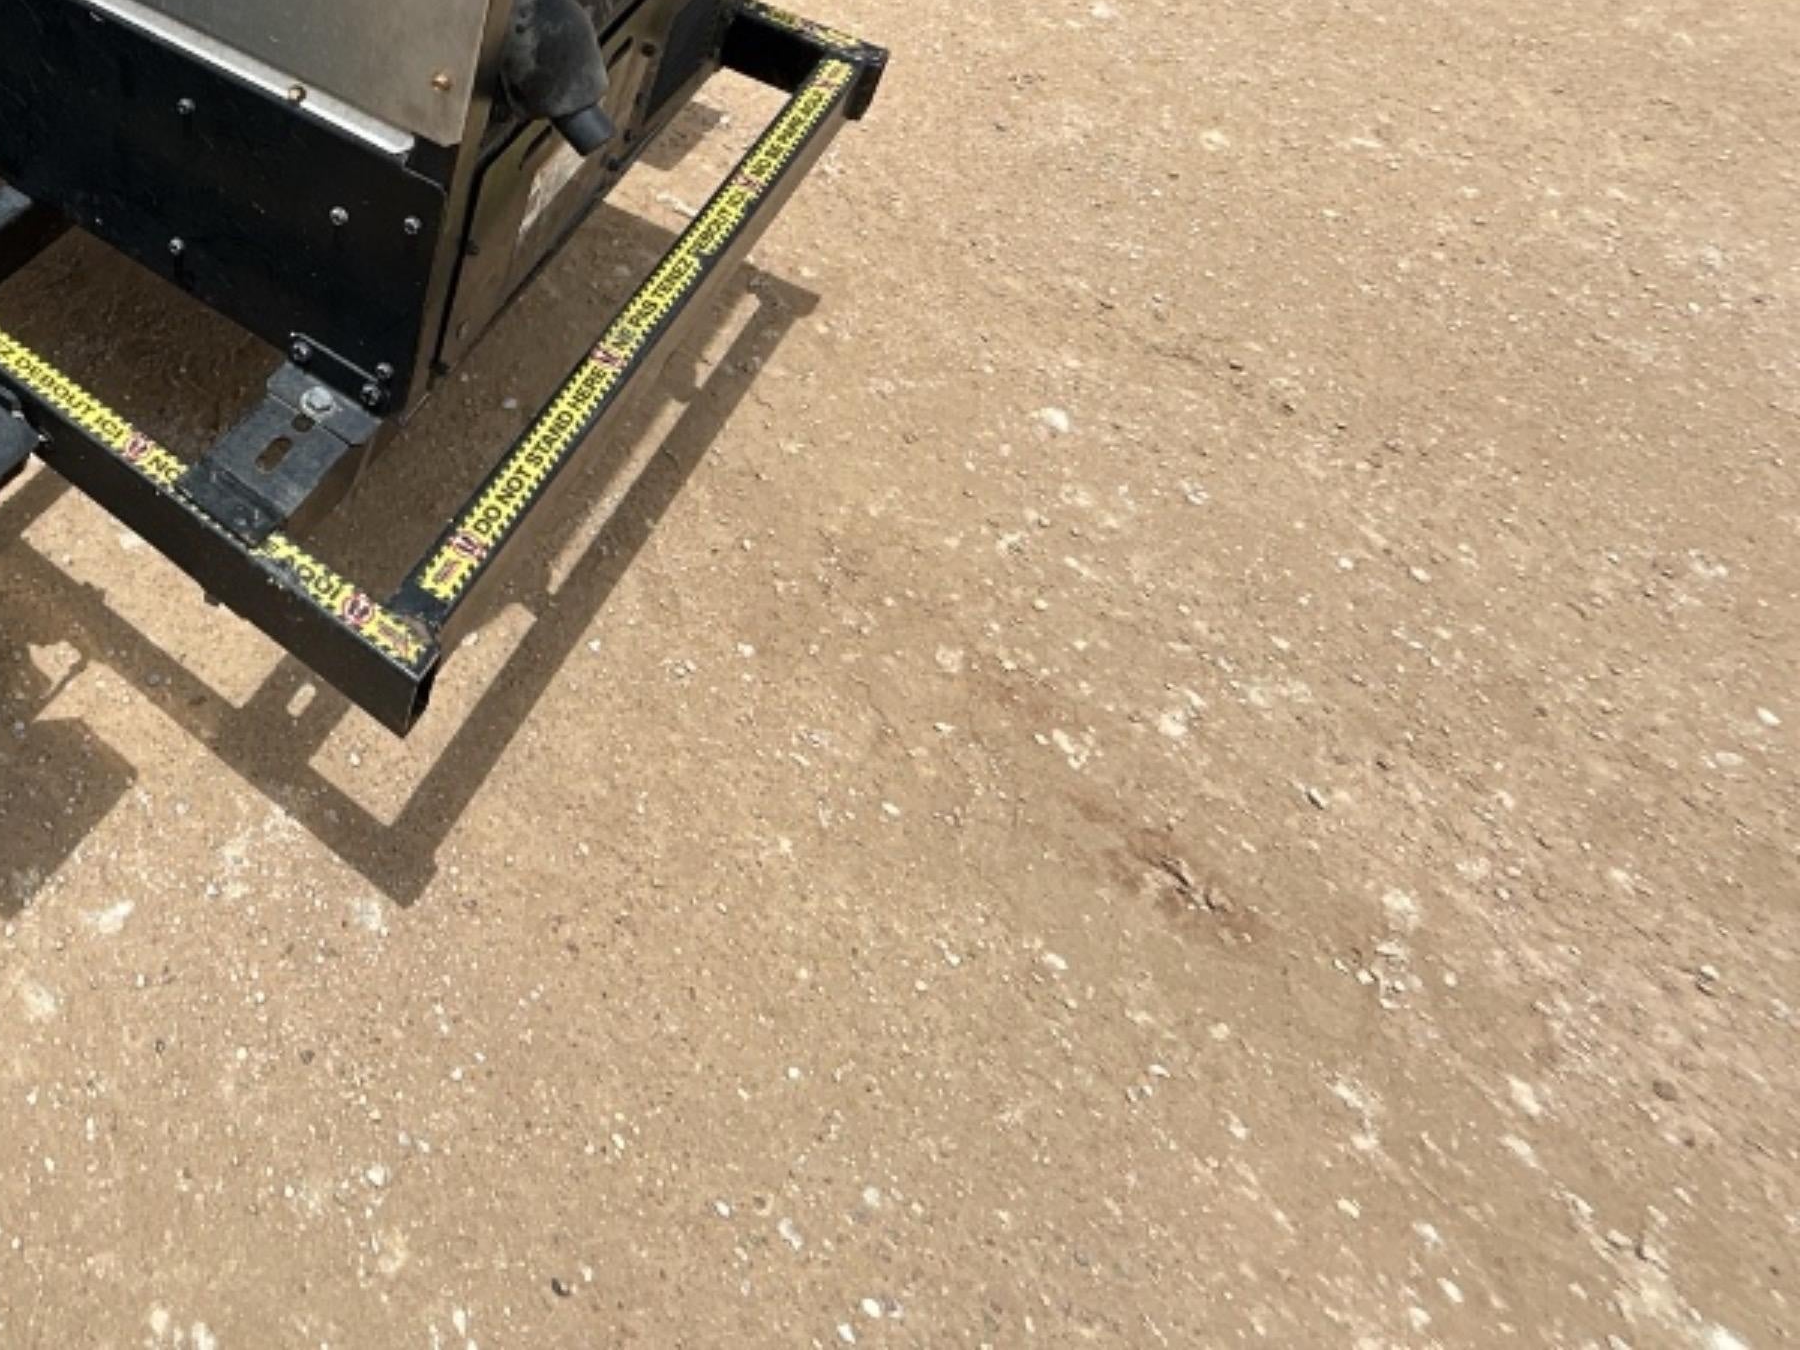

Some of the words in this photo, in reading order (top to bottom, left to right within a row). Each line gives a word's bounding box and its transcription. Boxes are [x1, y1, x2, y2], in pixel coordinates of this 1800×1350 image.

[14, 355, 94, 418] DEBOUT
[473, 504, 502, 535] DO
[496, 467, 531, 505] NOT
[526, 410, 572, 467] STAND
[652, 257, 690, 299] TENEZ
